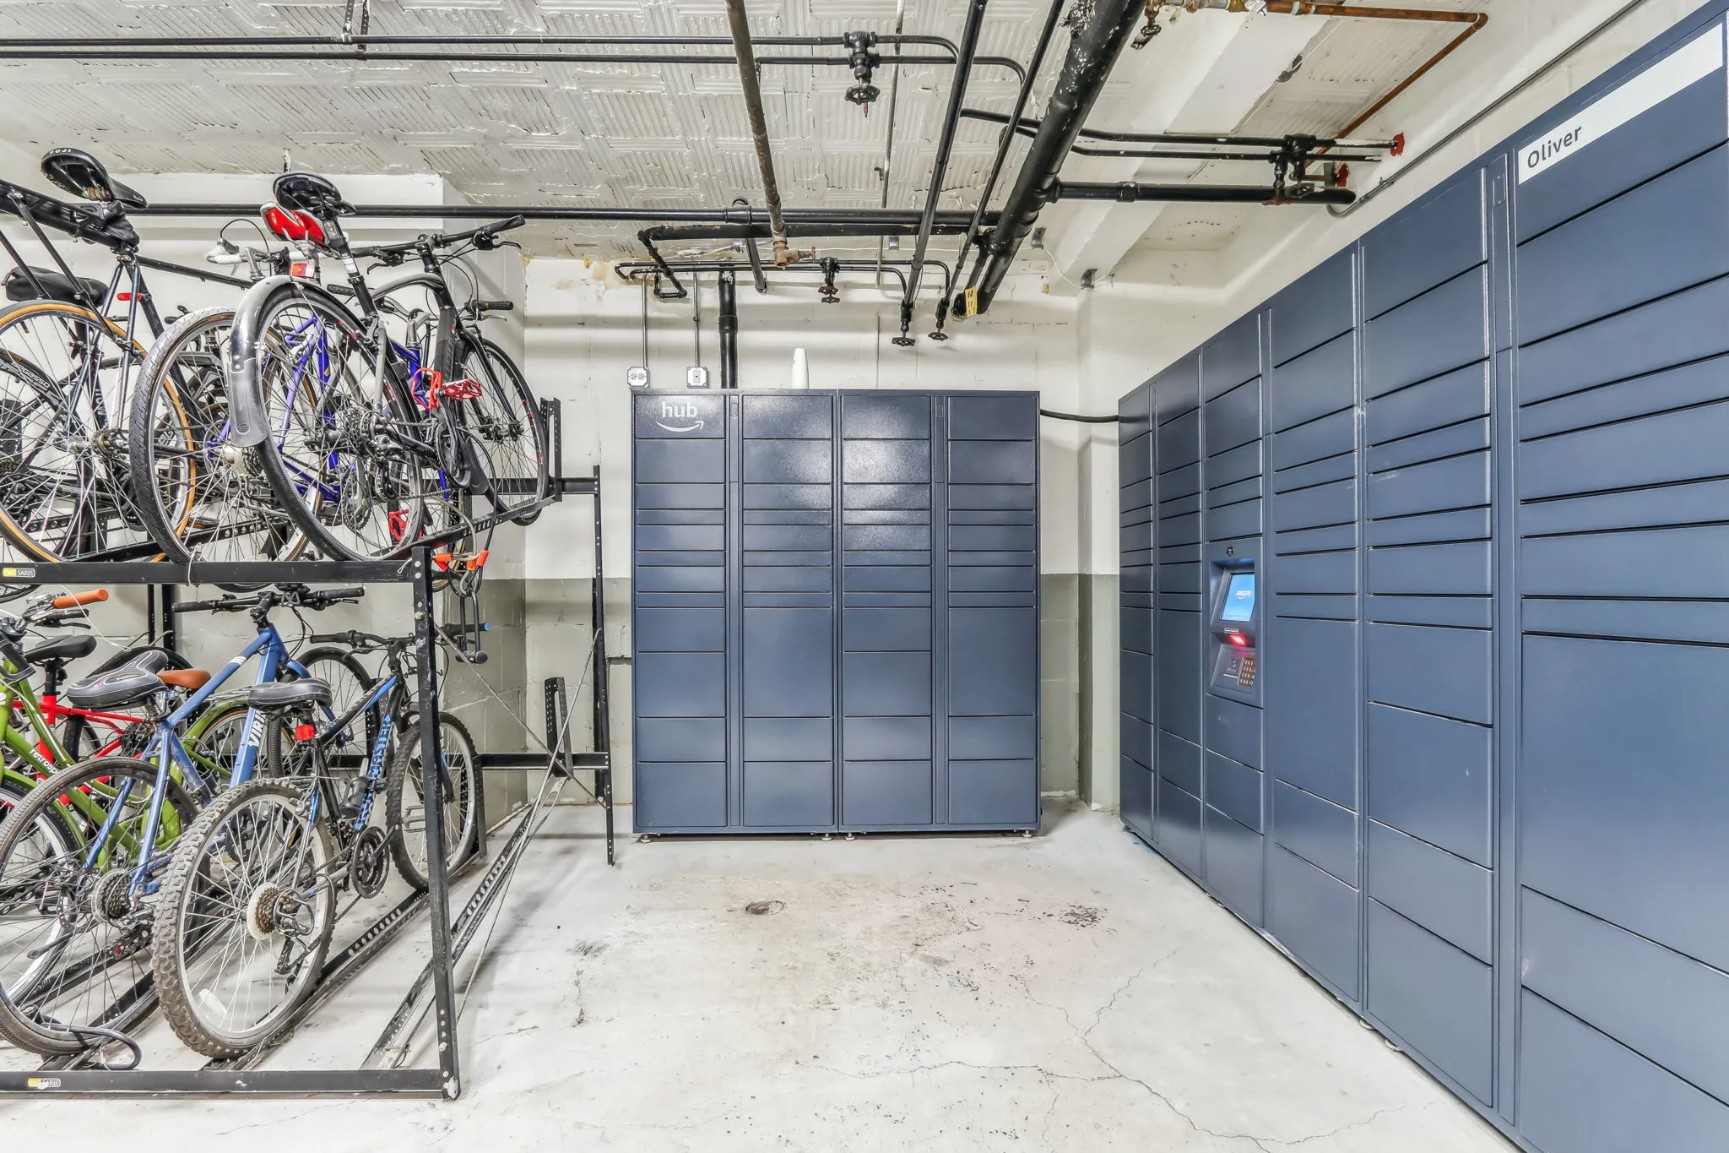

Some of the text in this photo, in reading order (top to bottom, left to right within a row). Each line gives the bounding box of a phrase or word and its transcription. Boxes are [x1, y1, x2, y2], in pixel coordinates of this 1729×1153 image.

[1527, 126, 1582, 168] Oliver
[661, 401, 699, 418] hub
[30, 749, 58, 774] retrosp
